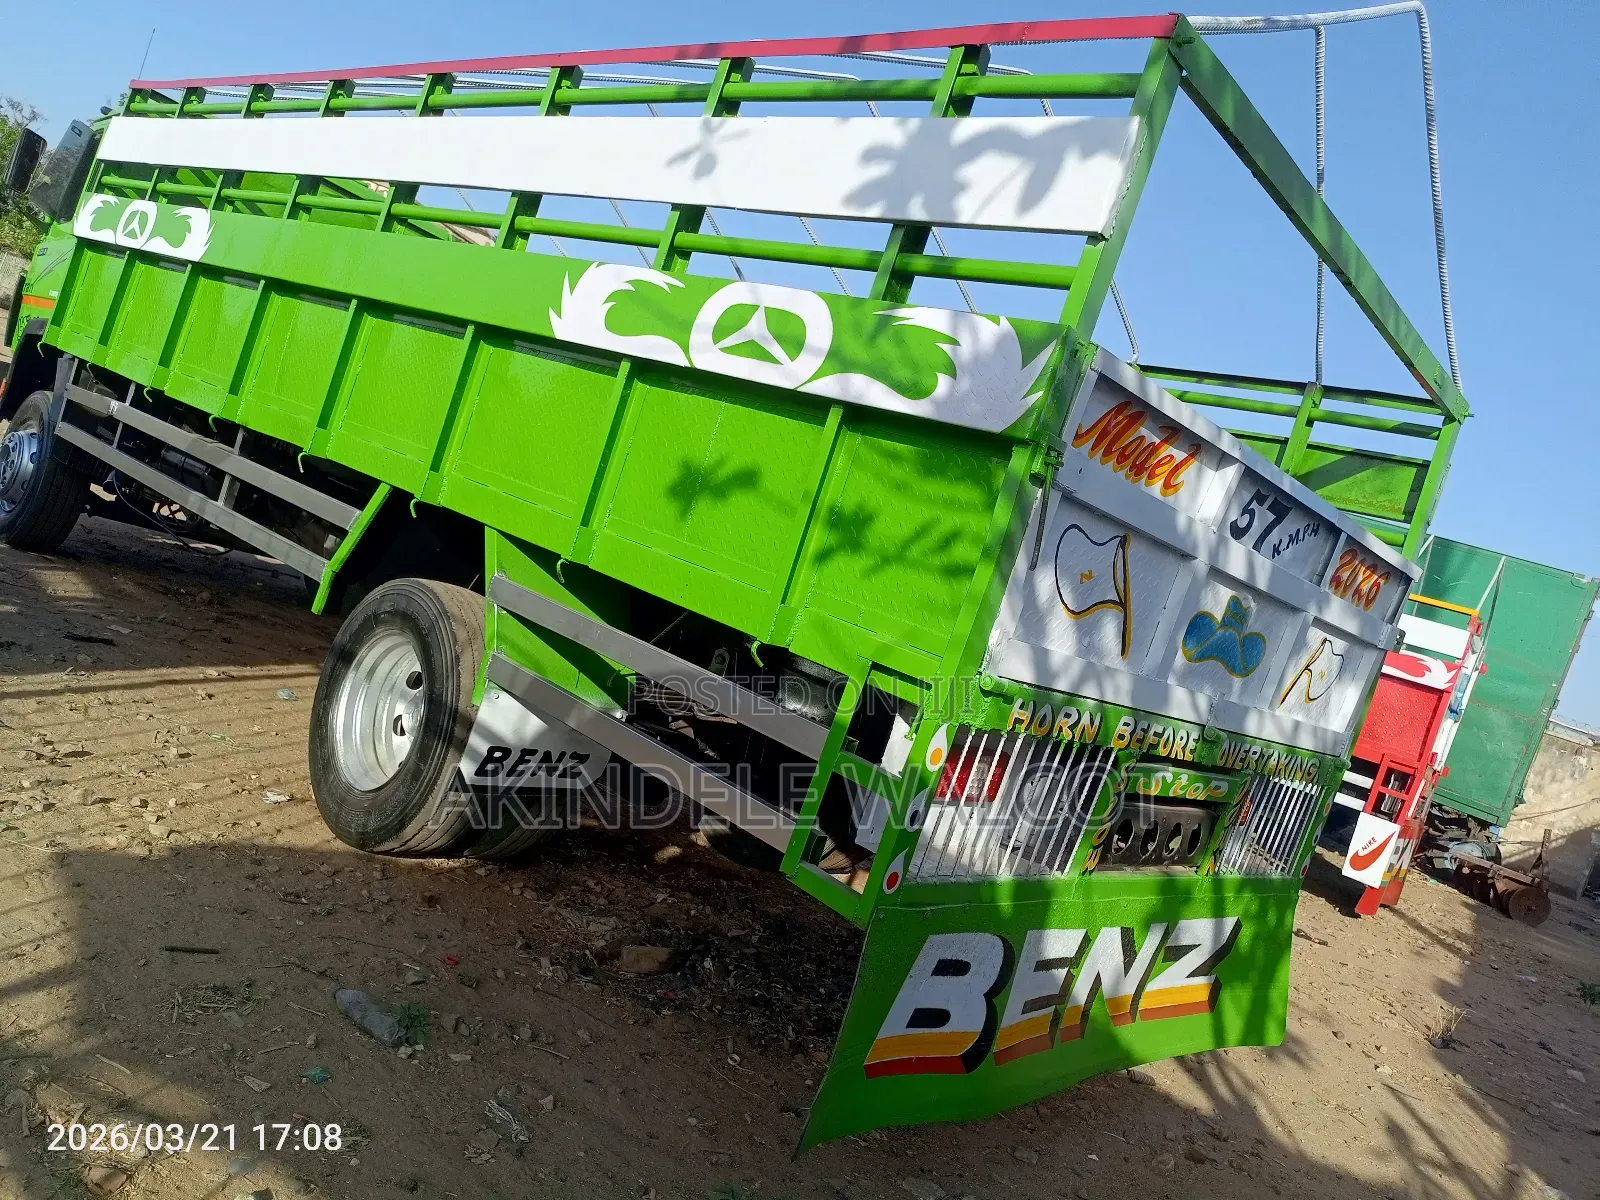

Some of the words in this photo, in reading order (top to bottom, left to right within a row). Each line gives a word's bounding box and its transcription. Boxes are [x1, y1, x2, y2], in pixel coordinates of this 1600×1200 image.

[1073, 401, 1201, 497] Model
[1229, 488, 1293, 553] 57
[1329, 549, 1392, 611] 2026
[474, 746, 590, 778] BENZ
[1007, 698, 1101, 744] HORN
[1111, 716, 1199, 761] BEFORE
[1216, 738, 1320, 782] OVERTAKING
[1361, 836, 1377, 851] NIKE
[863, 916, 1242, 1079] BENZ
